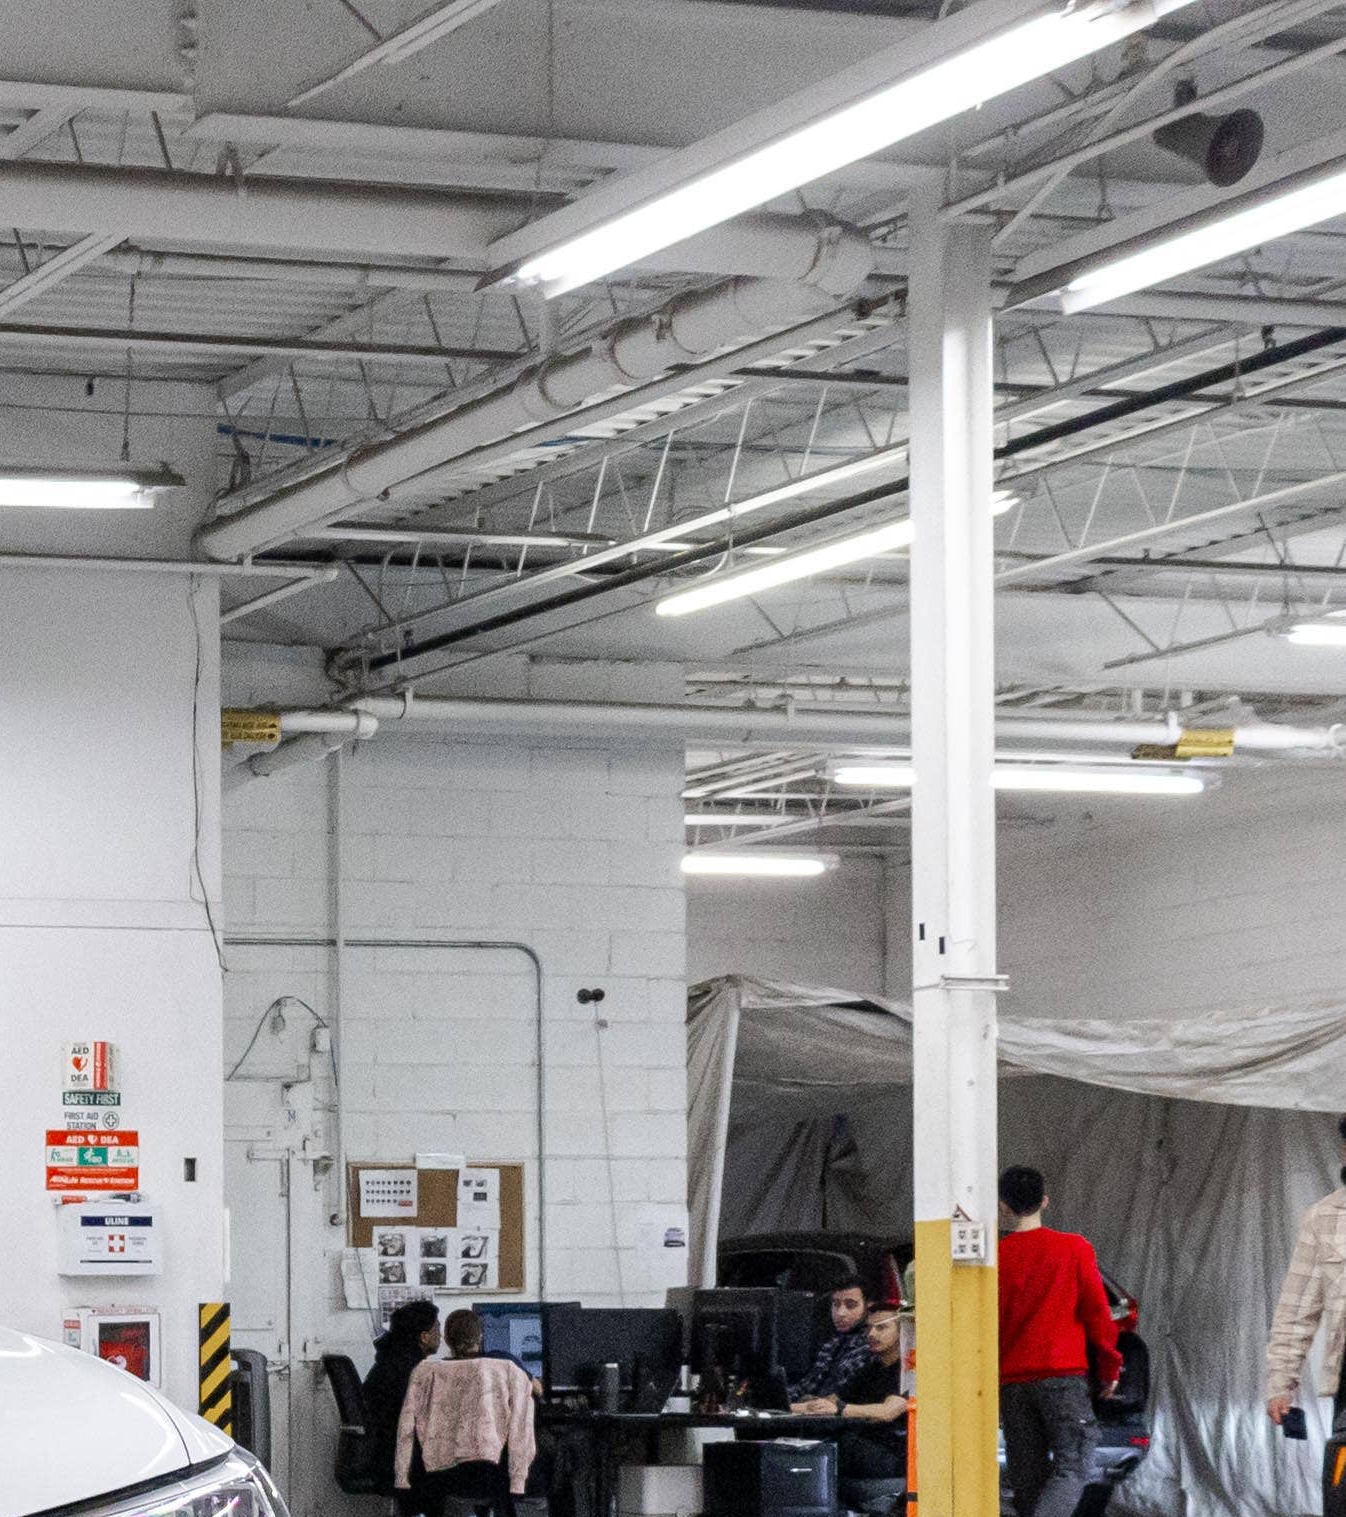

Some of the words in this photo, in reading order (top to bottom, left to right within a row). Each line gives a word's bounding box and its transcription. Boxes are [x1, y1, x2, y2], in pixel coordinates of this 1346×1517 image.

[71, 1047, 90, 1055] AED
[71, 1074, 89, 1082] DEA
[64, 1093, 94, 1105] SAFETY
[96, 1093, 119, 1105] FIRST
[64, 1111, 85, 1120] FIRST
[86, 1111, 99, 1120] AID
[66, 1121, 97, 1130] STATION
[66, 1135, 85, 1144] AED
[100, 1135, 119, 1144] DEA
[104, 1216, 129, 1225] ULINE
